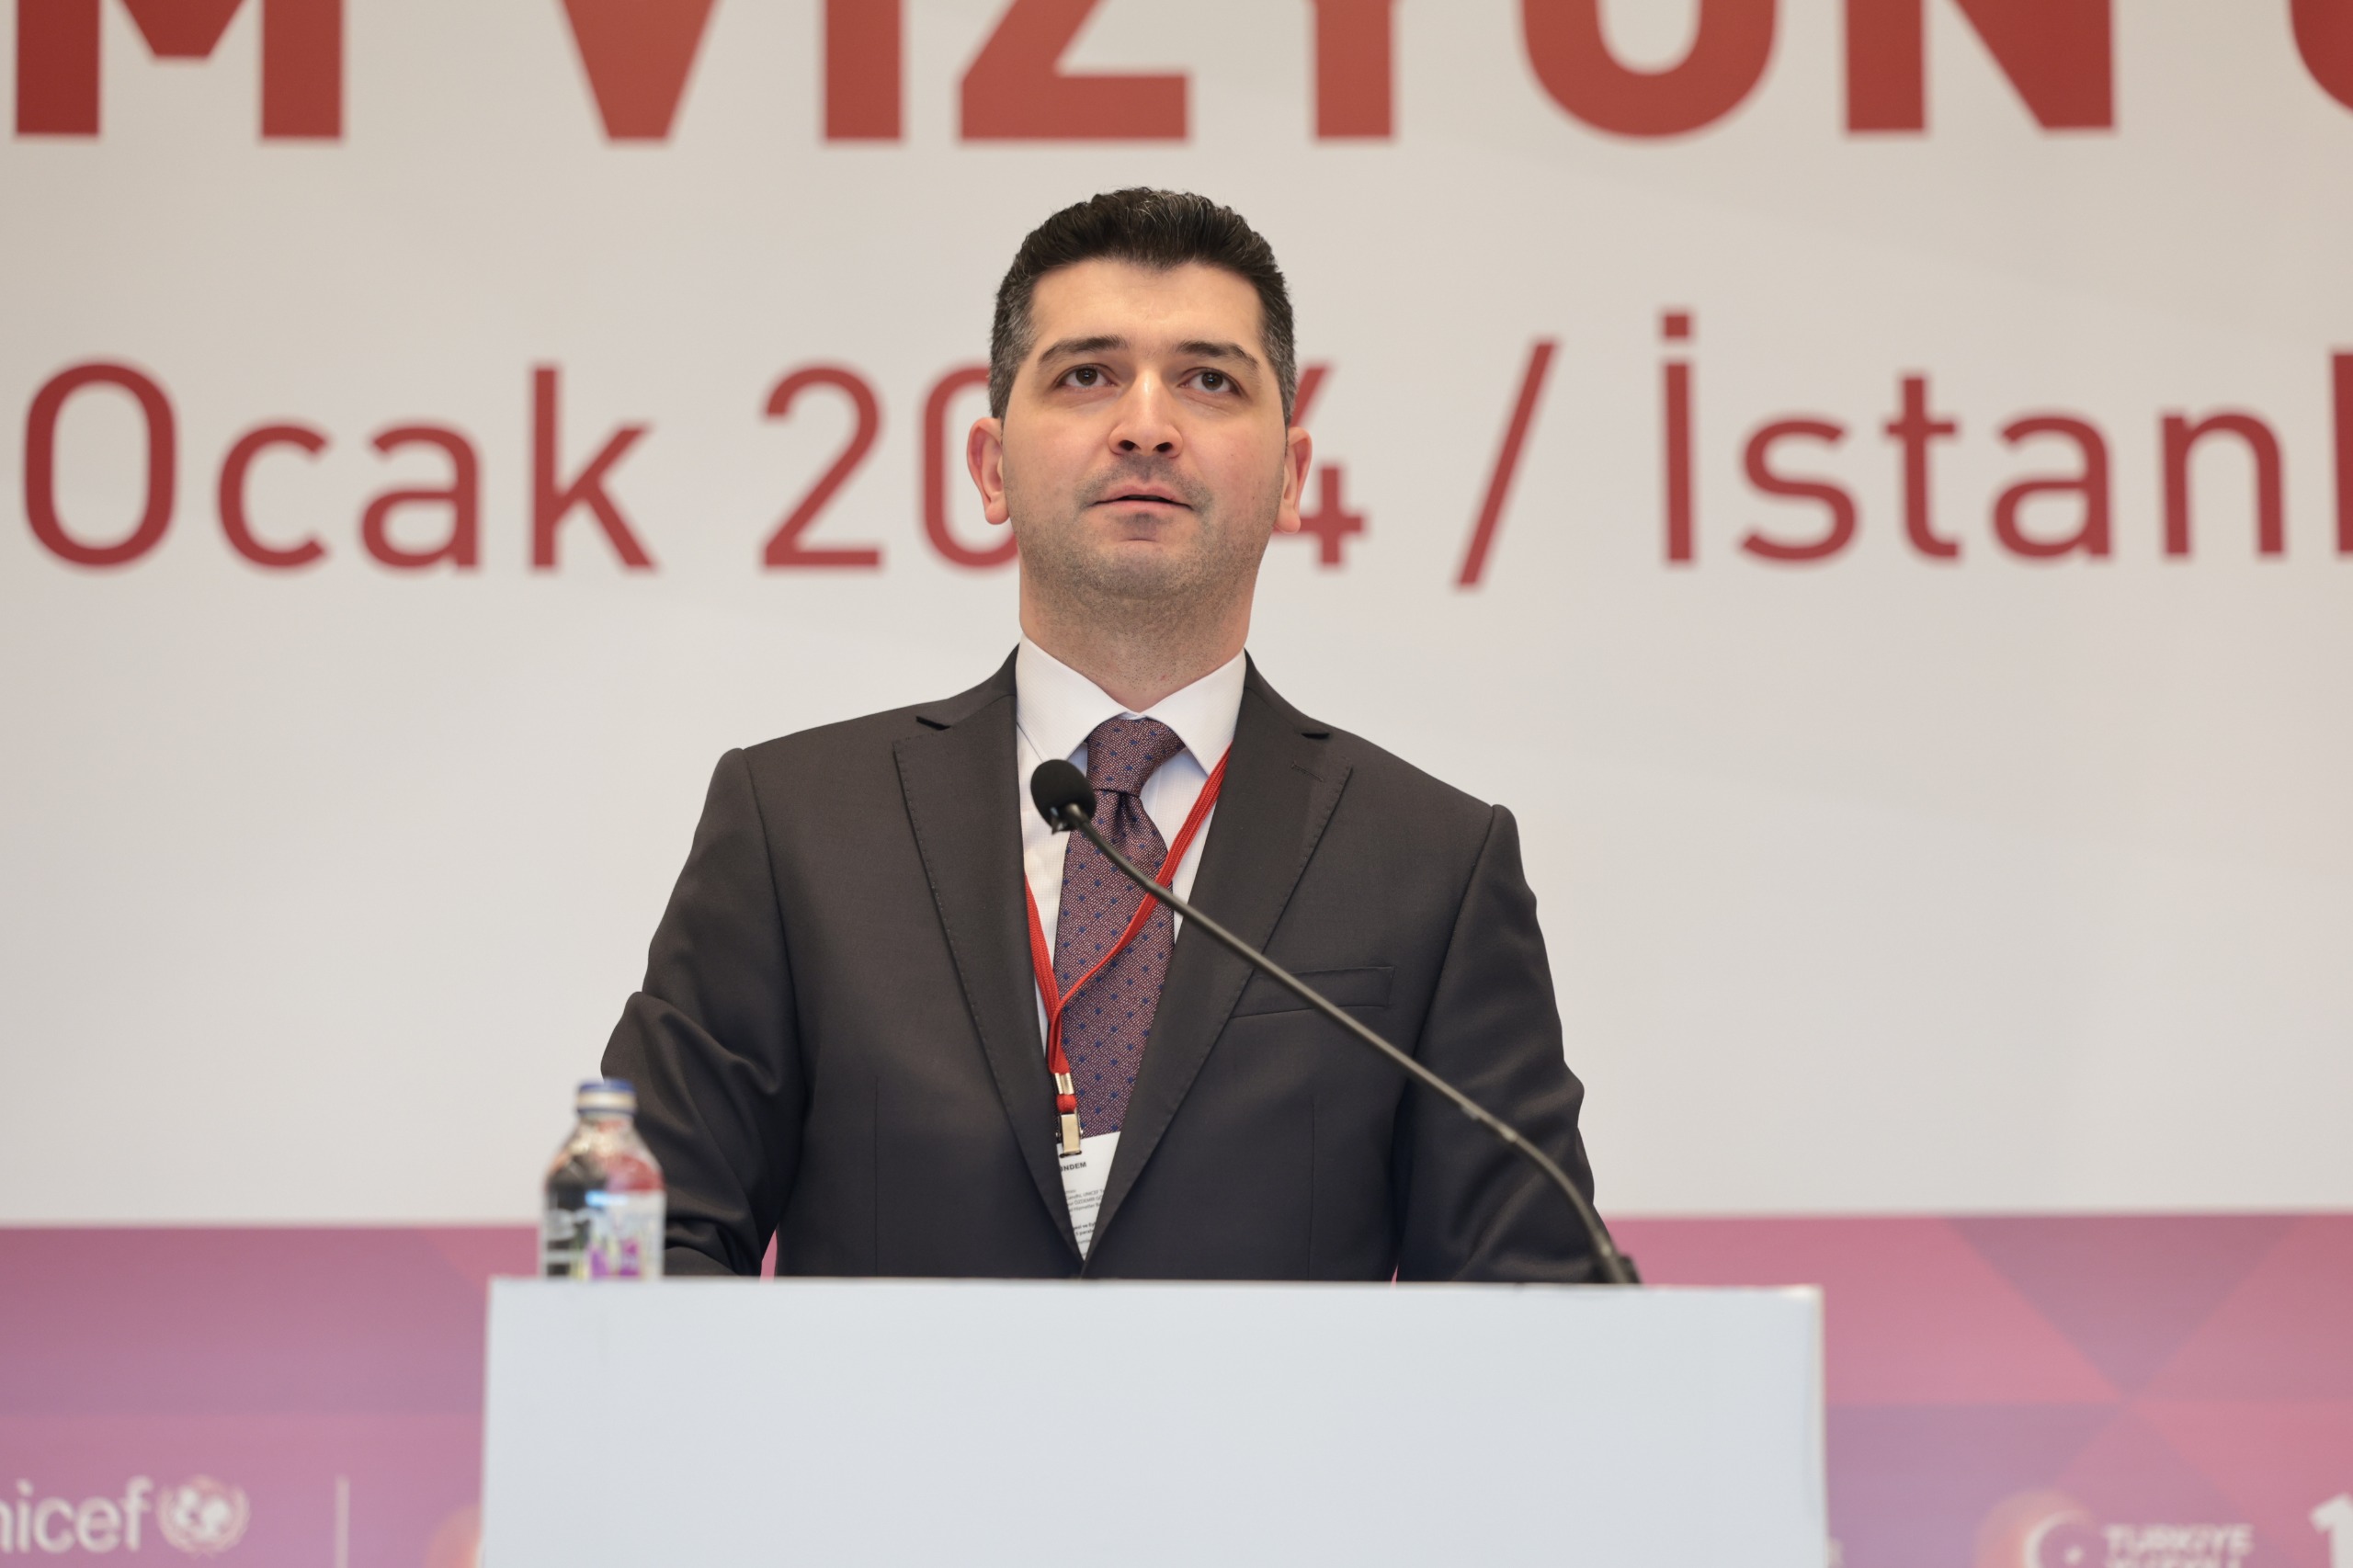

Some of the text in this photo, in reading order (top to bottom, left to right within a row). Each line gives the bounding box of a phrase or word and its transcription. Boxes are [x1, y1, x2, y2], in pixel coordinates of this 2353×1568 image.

[24, 309, 2353, 588] Ocak 204 / İstan
[1060, 1162, 1086, 1172] NDEM
